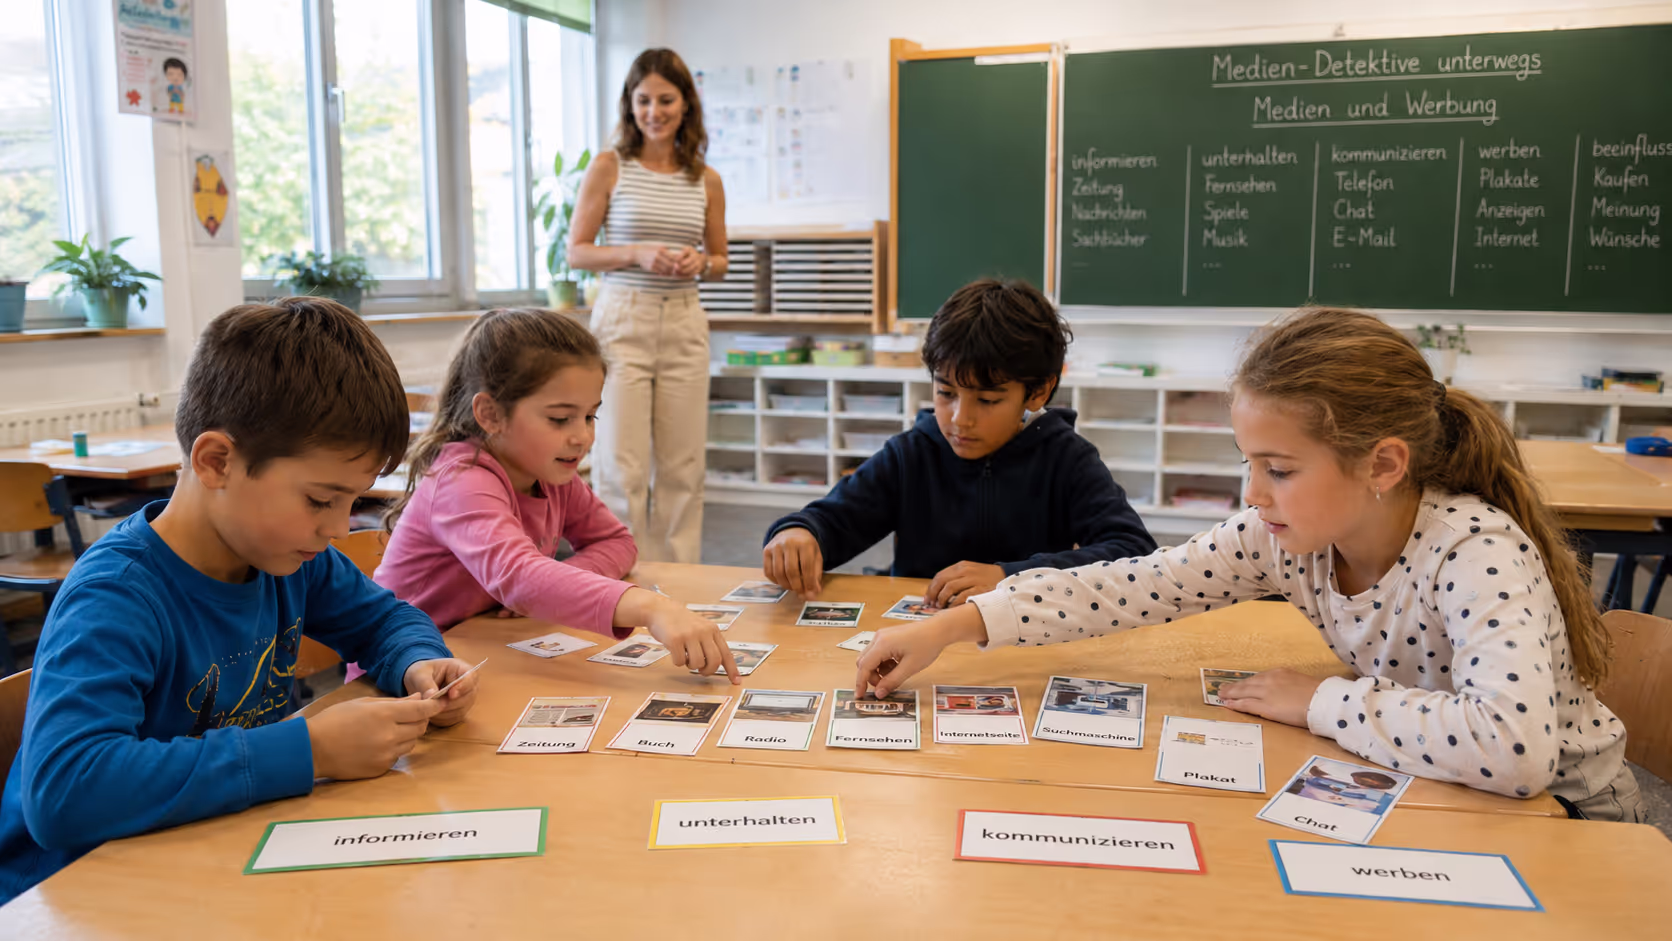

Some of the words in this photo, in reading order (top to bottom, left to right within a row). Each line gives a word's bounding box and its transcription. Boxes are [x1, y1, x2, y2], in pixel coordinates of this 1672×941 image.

[1211, 48, 1420, 81] Medien-Detektive
[1438, 44, 1542, 80] unterwegs
[1252, 96, 1332, 122] Medien
[1347, 92, 1389, 118] und
[1405, 89, 1497, 126] Werbung
[1202, 145, 1297, 167] unterhalten
[1332, 145, 1447, 161] kommunizieren
[1479, 138, 1540, 159] werben
[1071, 148, 1157, 175] informieren
[1204, 175, 1276, 194] Fernsehen
[1334, 170, 1393, 197] Telefon
[1480, 167, 1540, 189] Plakate
[1594, 166, 1649, 192] Kaufen
[1072, 178, 1124, 202] Zeitung
[1204, 201, 1249, 225] Spiele
[1334, 199, 1375, 219] Chat
[1476, 199, 1545, 226] Anzeigen
[1592, 197, 1661, 226] Meinung
[1203, 230, 1247, 248] Musik
[1333, 227, 1396, 248] E-Mail
[1475, 227, 1539, 248] Internet
[1589, 227, 1661, 248] Wünsche
[516, 738, 577, 750] Zeitung
[637, 739, 676, 749] Buch
[743, 734, 787, 745] Radio
[834, 734, 914, 745] Fernsehen
[939, 730, 1022, 740] Internetseite
[1041, 725, 1137, 743] Suchmaschine
[1182, 770, 1238, 785] Plakat
[678, 814, 817, 828] unterhalten
[1293, 814, 1340, 834] Chat
[333, 829, 478, 847] informieren
[981, 827, 1176, 851] kommunizieren
[1350, 866, 1451, 882] werben
